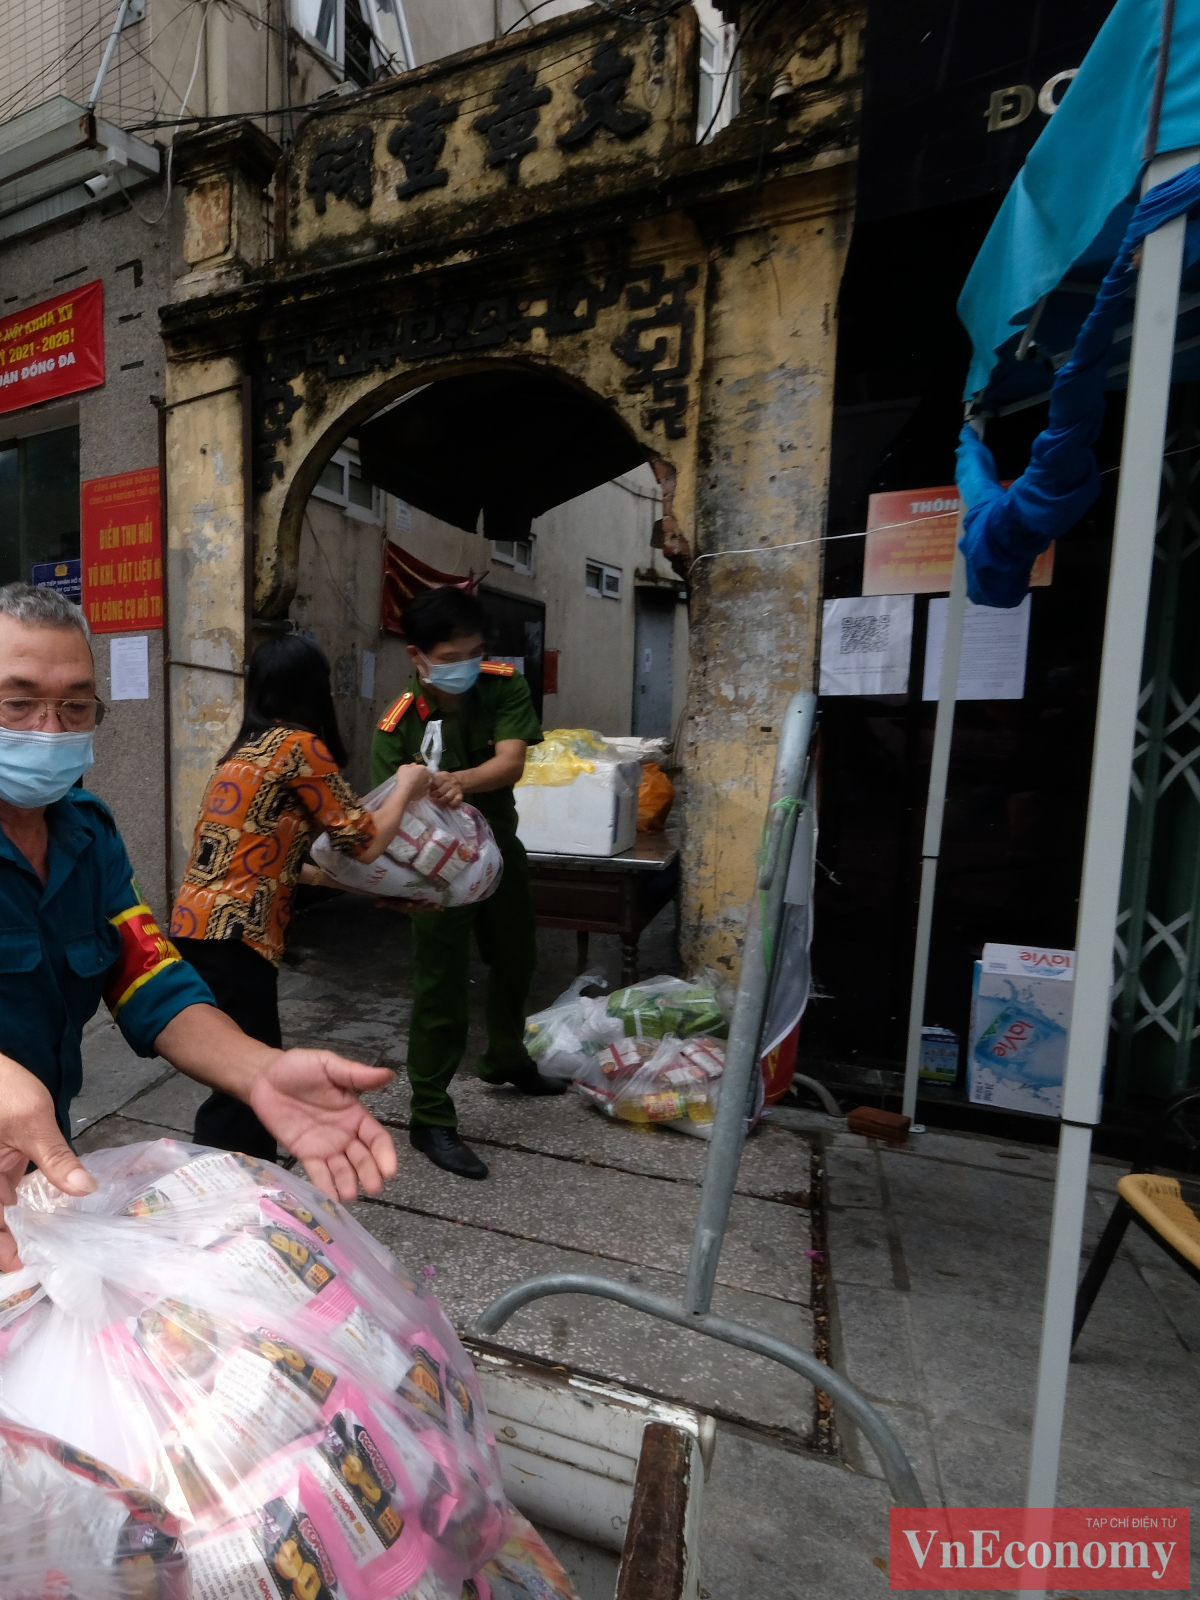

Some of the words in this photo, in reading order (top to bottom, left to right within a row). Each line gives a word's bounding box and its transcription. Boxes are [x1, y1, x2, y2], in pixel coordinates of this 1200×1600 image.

[57, 303, 74, 324] XV
[20, 359, 56, 380] ĐỐNG
[57, 351, 76, 368] ĐA
[910, 498, 960, 514] THÔN
[100, 519, 120, 550] ĐIỂM
[121, 523, 137, 547] THU
[88, 562, 98, 587] VŨ
[117, 557, 132, 588] VẬT
[134, 555, 153, 586] LIỆU
[90, 597, 100, 622] VÀ
[101, 597, 123, 622] CÔNG
[125, 598, 136, 624] CỤ
[359, 1430, 394, 1489] KOKOMI
